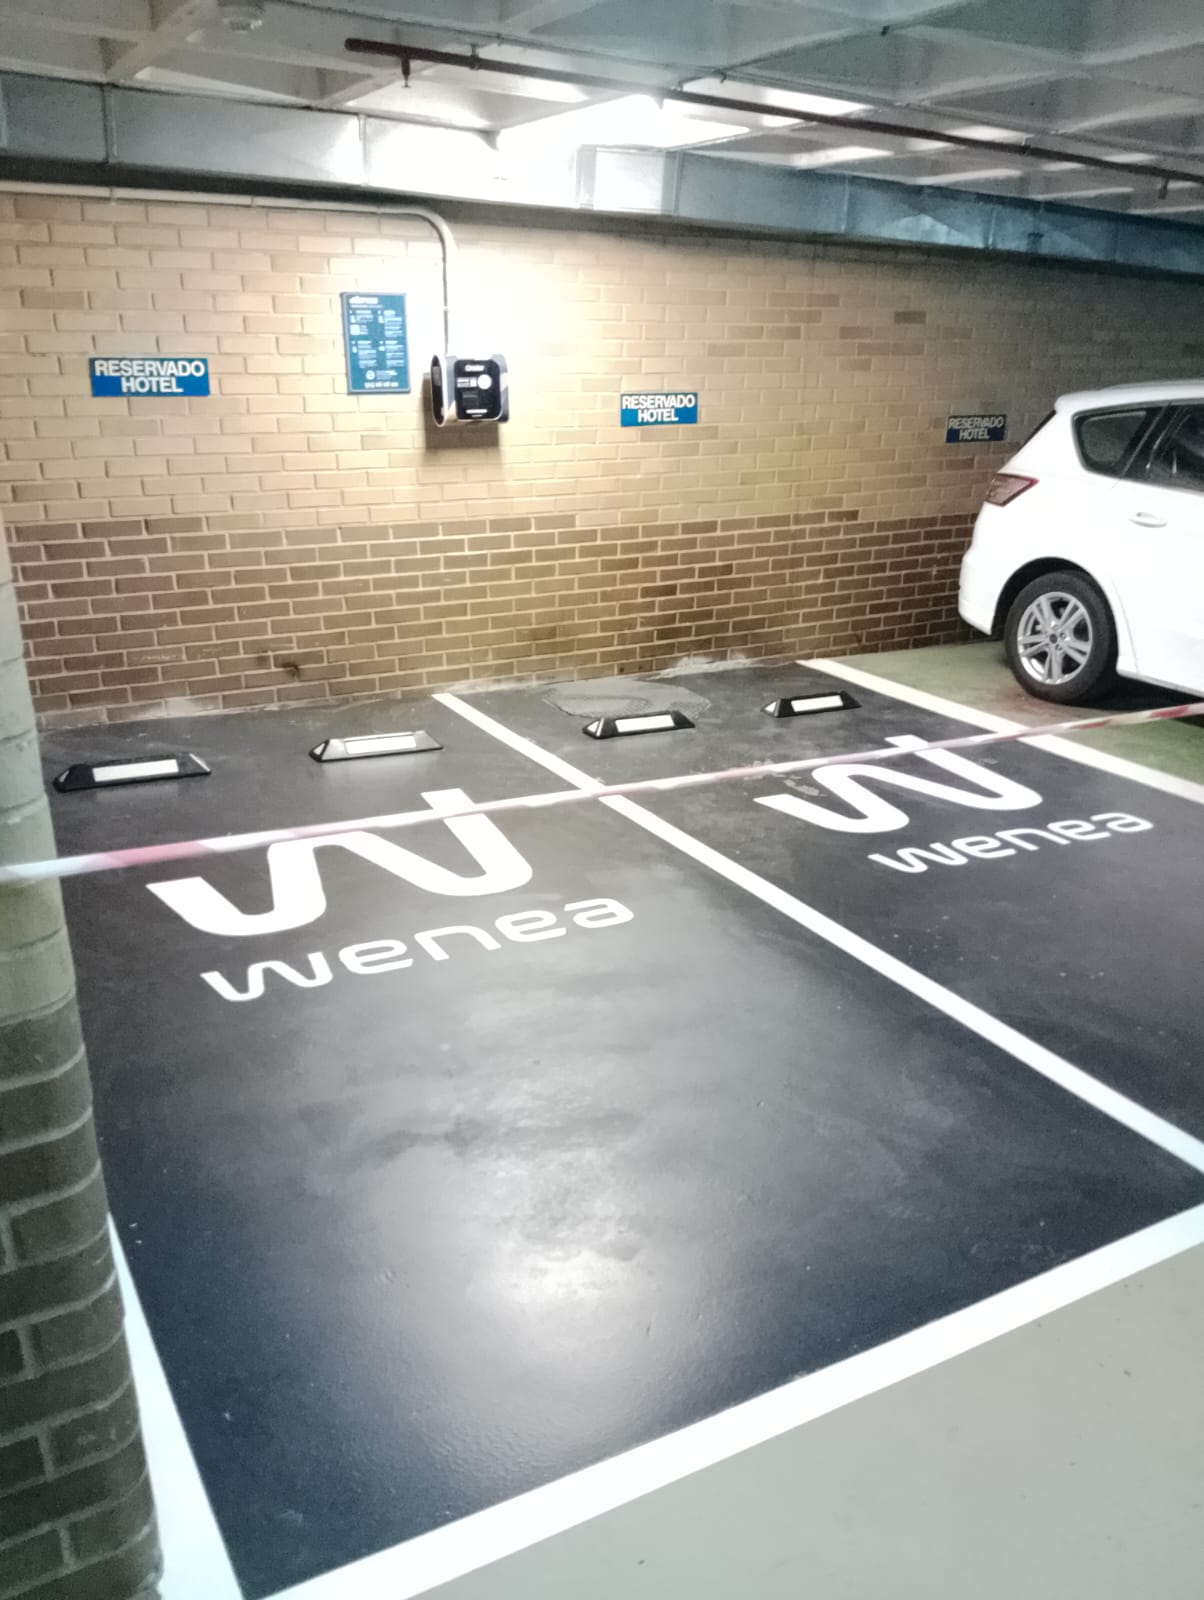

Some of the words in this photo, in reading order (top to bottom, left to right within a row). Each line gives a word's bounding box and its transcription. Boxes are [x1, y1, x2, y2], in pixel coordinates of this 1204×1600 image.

[94, 360, 206, 377] RESERVADO
[121, 377, 184, 393] HOTEL
[622, 394, 696, 410] RESERVADO
[638, 408, 680, 423] HOTEL
[949, 416, 1004, 429] RESERVADO
[959, 428, 990, 441] HOTEL
[867, 811, 1154, 874] wenea
[200, 897, 635, 1002] wenea
